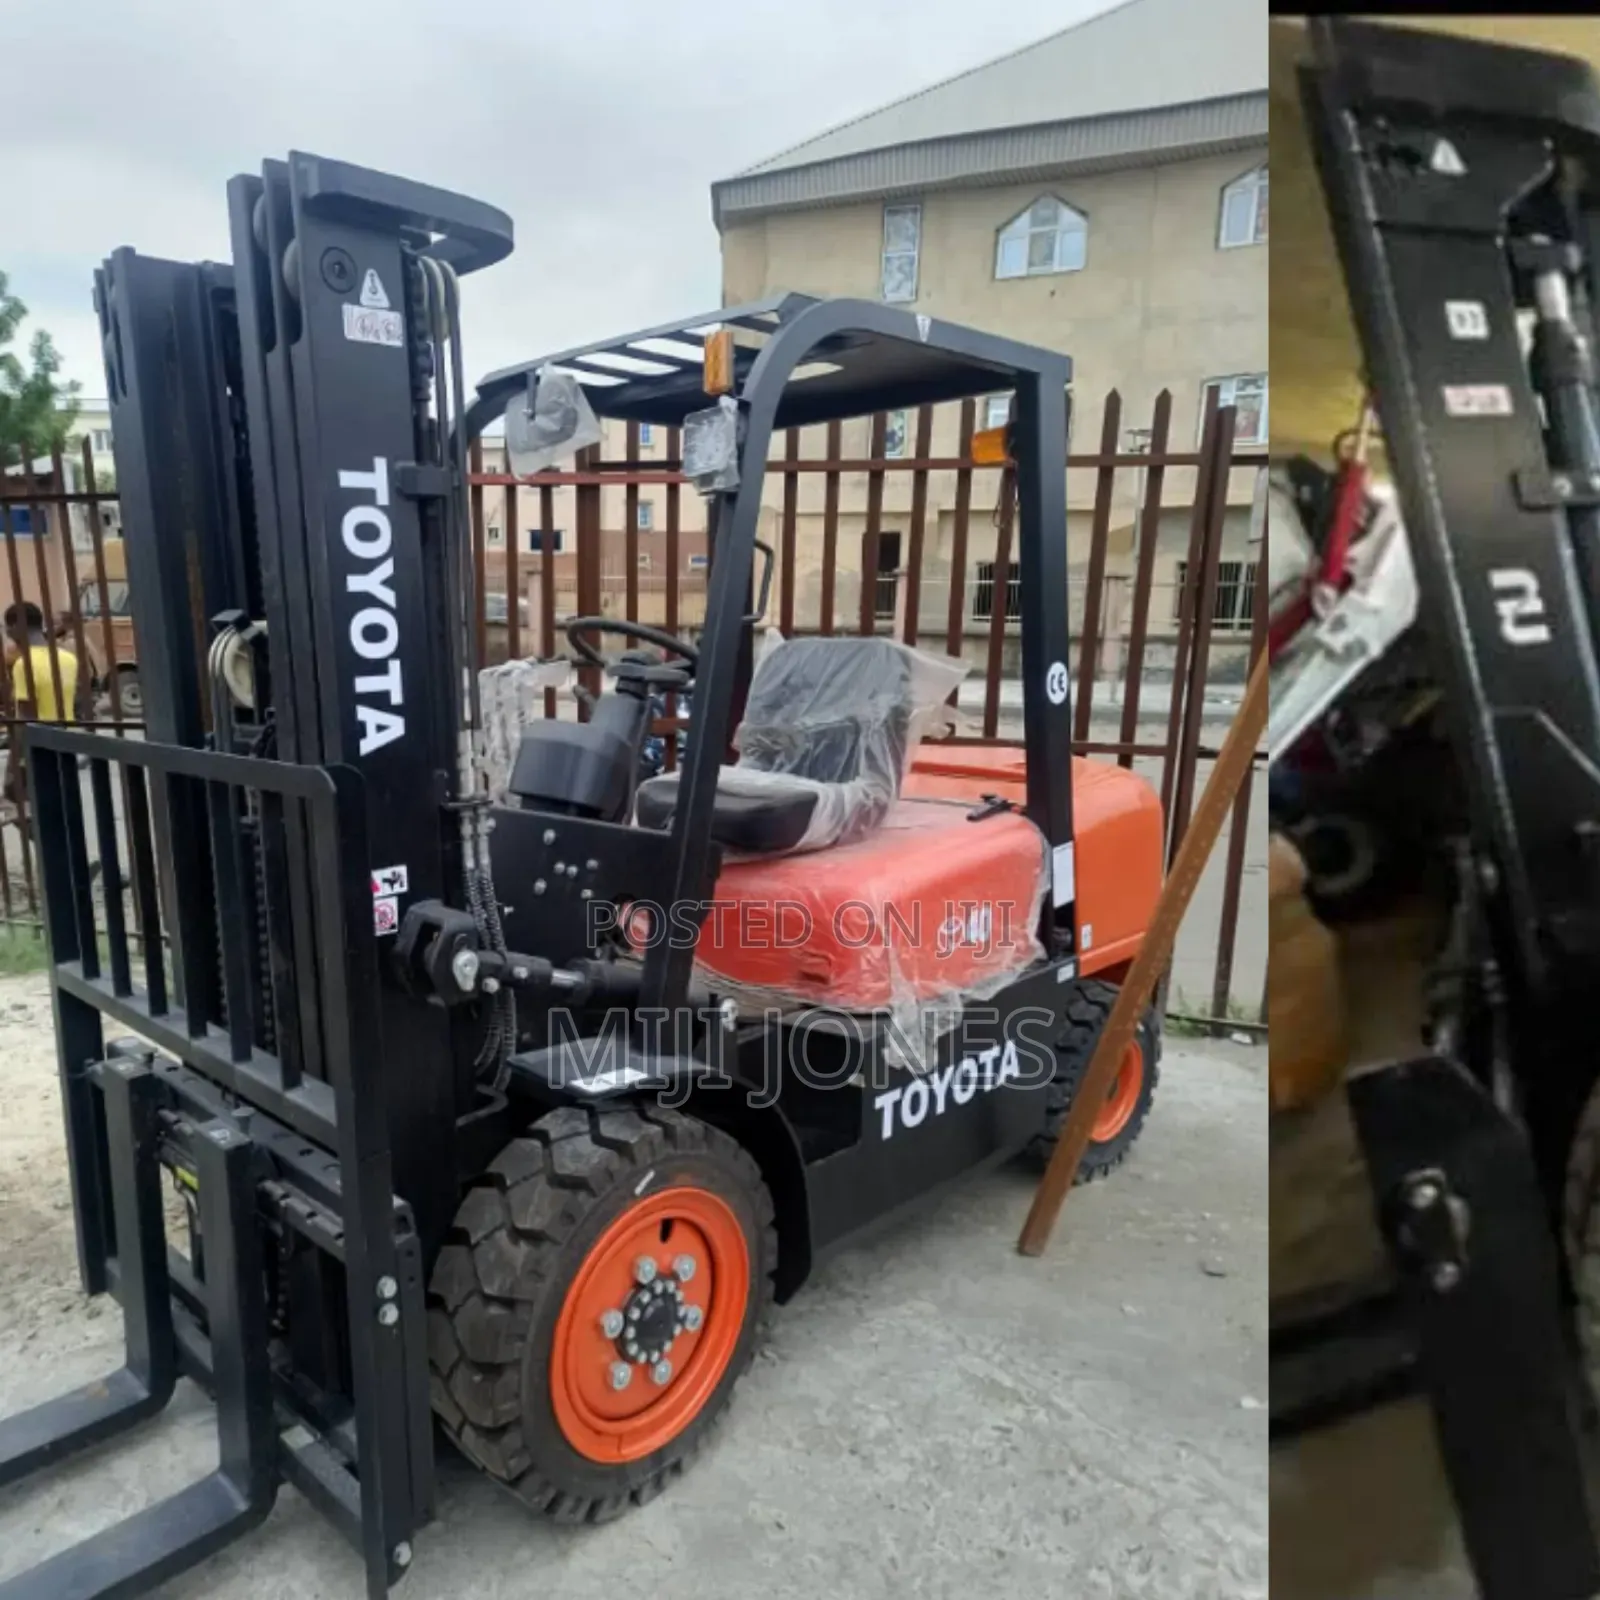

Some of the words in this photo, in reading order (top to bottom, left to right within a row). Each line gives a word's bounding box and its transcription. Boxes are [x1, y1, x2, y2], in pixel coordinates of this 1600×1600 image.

[337, 456, 405, 757] TOYOTA
[1050, 672, 1065, 695] CE
[874, 1039, 1020, 1141] TOYOTA
